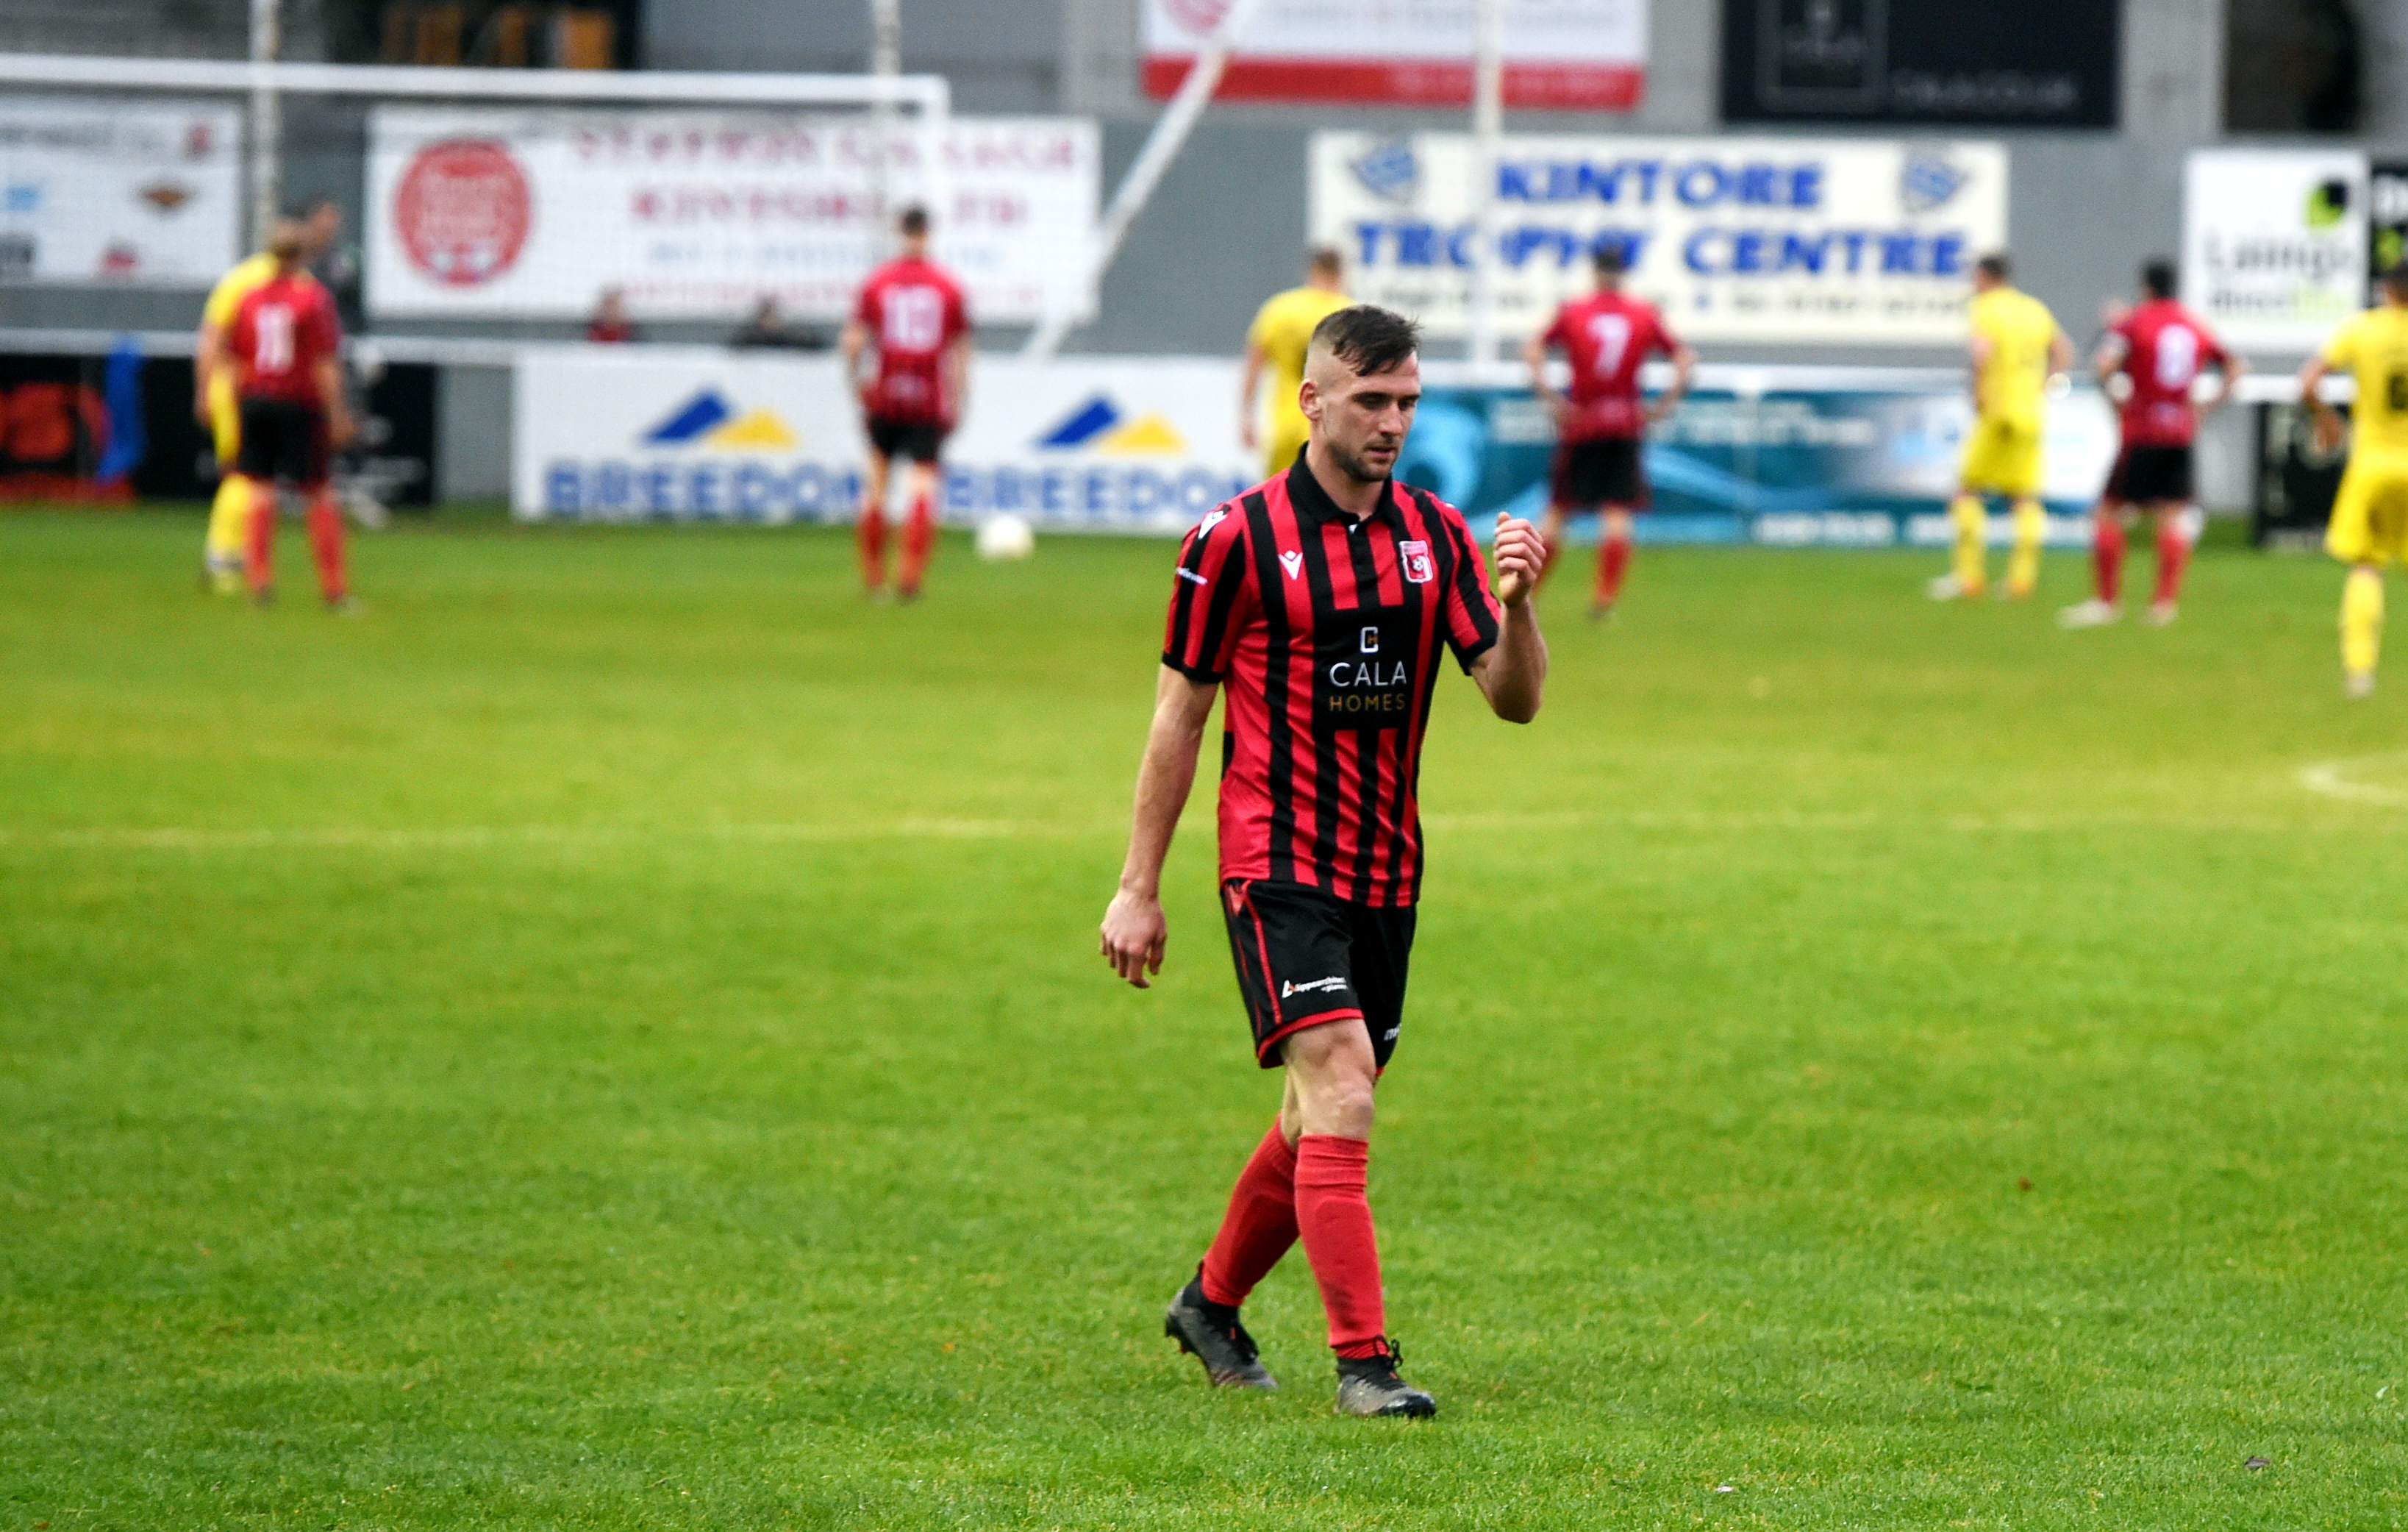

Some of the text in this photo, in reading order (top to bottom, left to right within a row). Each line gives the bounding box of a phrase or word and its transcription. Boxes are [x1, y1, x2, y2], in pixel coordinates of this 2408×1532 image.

[1497, 159, 1821, 207] KINTORE
[1356, 222, 1966, 277] TROPHY CENTRE
[1585, 312, 1631, 378] 7
[1329, 660, 1407, 688] CALA
[1329, 694, 1406, 712] HOMES
